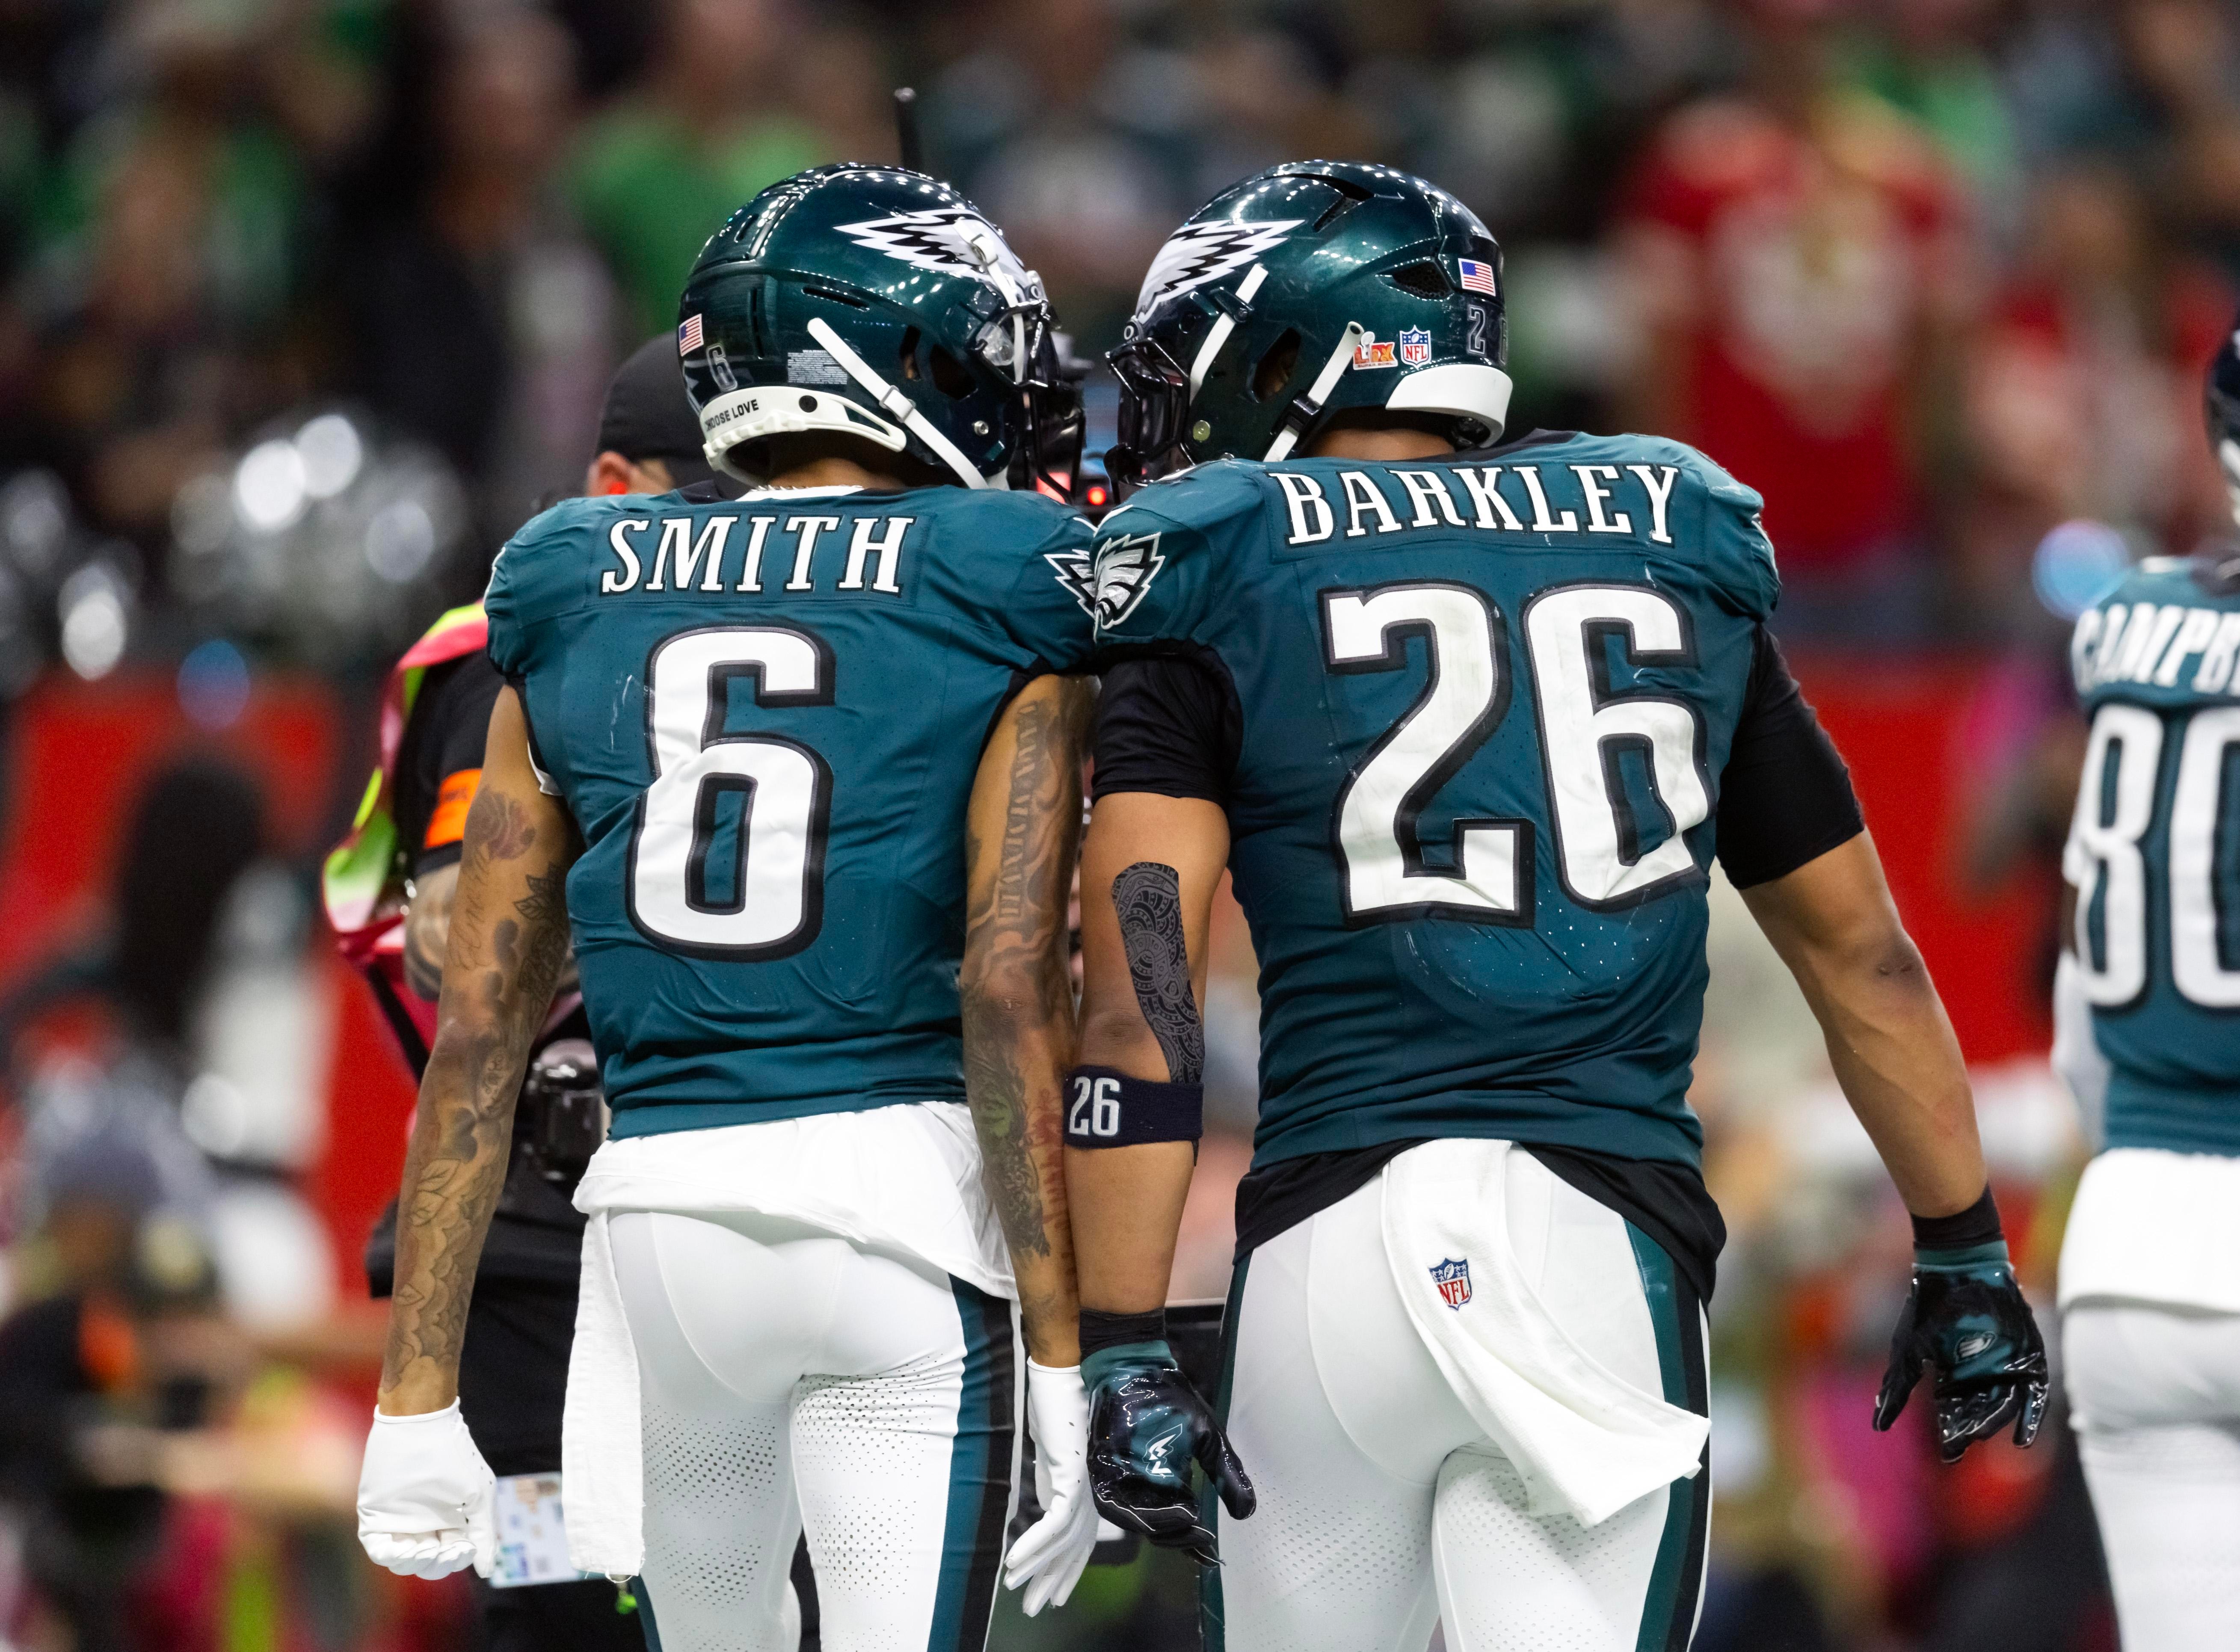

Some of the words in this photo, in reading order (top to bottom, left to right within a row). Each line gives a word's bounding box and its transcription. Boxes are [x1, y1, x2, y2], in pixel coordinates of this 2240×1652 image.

[706, 344, 738, 392] 6
[1405, 345, 1427, 362] NFL
[732, 399, 759, 418] LOVE
[1269, 464, 1680, 546] BARKLEY
[601, 516, 919, 596] SMITH
[2071, 602, 2240, 696] CAMPB
[627, 625, 833, 960] 6
[1319, 580, 1710, 927] 26
[2064, 703, 2240, 1006] 80
[1069, 1076, 1121, 1137] 26
[1437, 1279, 1469, 1305] NFL
